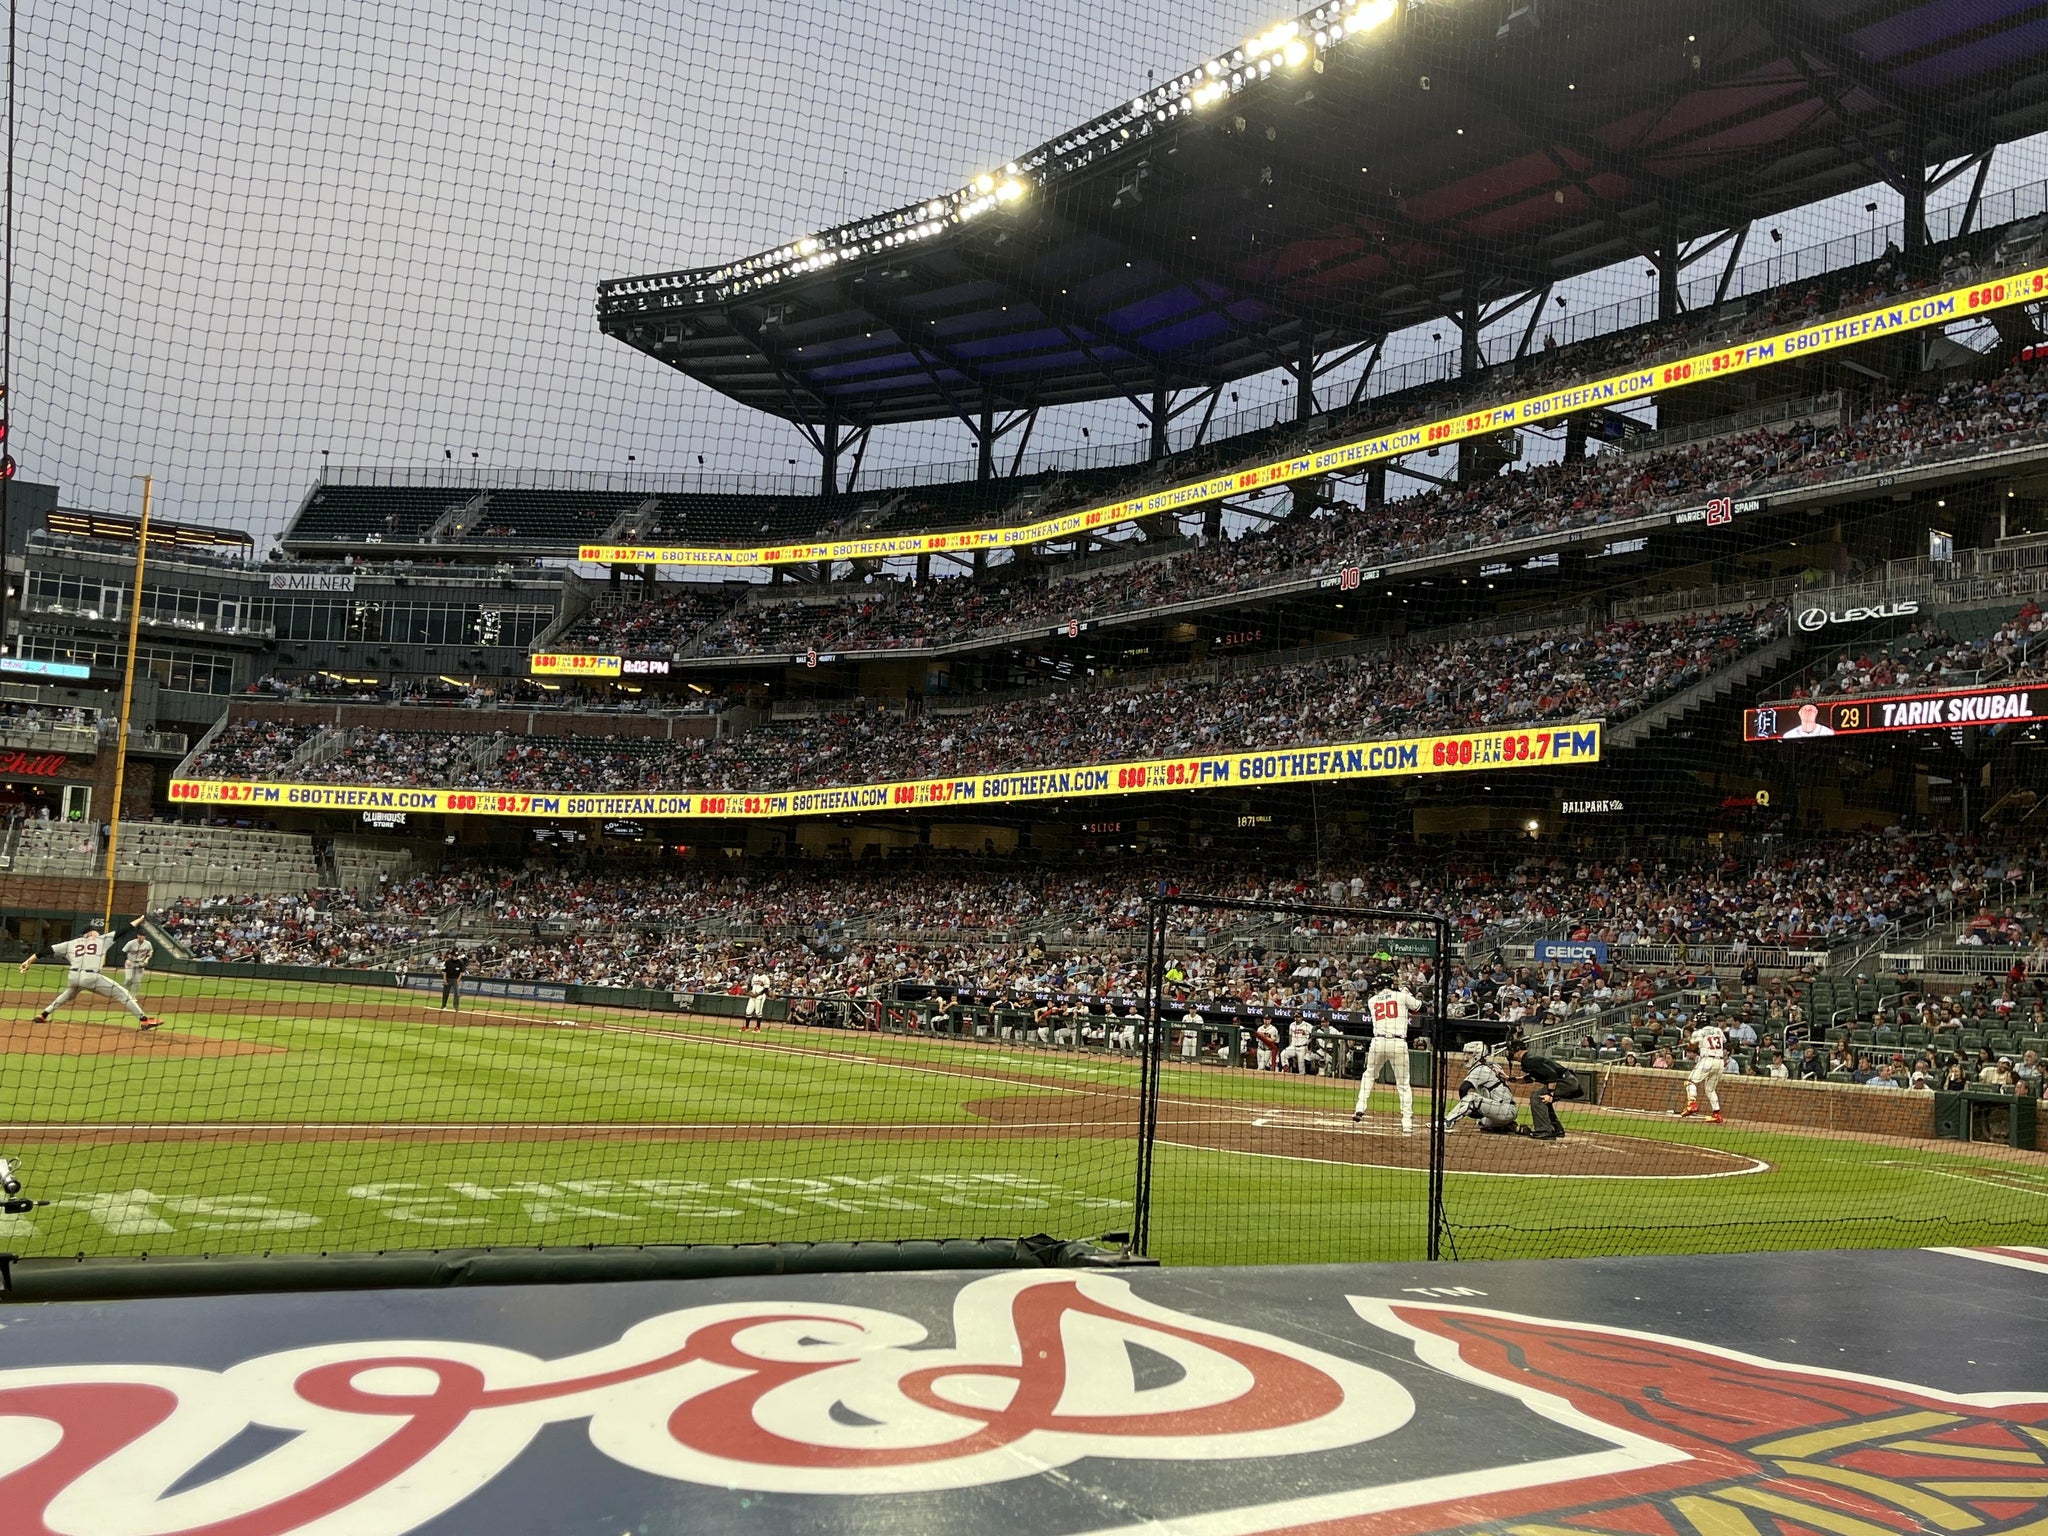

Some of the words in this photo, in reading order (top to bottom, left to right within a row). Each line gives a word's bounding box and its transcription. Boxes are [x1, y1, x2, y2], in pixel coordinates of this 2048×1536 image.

[2007, 278, 2030, 291] THE
[1969, 285, 2004, 308] 680
[2007, 288, 2030, 300] FAN
[1784, 297, 1954, 353] 680THEFAN.COM
[1692, 358, 1711, 369] THE
[1664, 364, 1690, 383] 680
[1692, 366, 1711, 378] FAN
[1523, 373, 1654, 417] 680THEFAN.COM
[1428, 425, 1450, 441] 680
[1316, 432, 1420, 468] 680THEFAN.COM
[1240, 473, 1256, 487] 680
[1148, 479, 1233, 509] 680THEFAN.COM
[1676, 510, 1706, 524] WARREN
[1707, 497, 1732, 526] 21
[1735, 501, 1759, 513] SPAHN
[1086, 514, 1100, 525] 680
[1004, 517, 1080, 542] 680THEFAN.COM
[833, 539, 922, 556] 680THEFAN.COM
[928, 538, 946, 549] 680
[581, 549, 600, 559] 680
[662, 551, 758, 562] 680THEFAN.COM
[764, 550, 780, 560] 680
[289, 575, 351, 590] MILNER
[1341, 567, 1360, 590] 10
[1830, 601, 1919, 623] LEXUS
[1069, 619, 1078, 637] 6
[1225, 630, 1261, 645] SLICE
[535, 656, 556, 666] 680
[807, 651, 816, 667] 3
[623, 661, 648, 673] 8:02
[650, 662, 669, 674] PM
[1840, 709, 1859, 729] 29
[1883, 700, 1944, 727] TARIK
[1948, 693, 2033, 722] SKUBAL
[1474, 738, 1501, 751] THE
[1433, 741, 1472, 766] 680
[1474, 750, 1501, 763] FAN
[1239, 745, 1418, 780] 680THEFAN.COM
[1118, 767, 1146, 788] 680
[1147, 765, 1165, 776] THE
[201, 784, 219, 793] THE
[982, 770, 1109, 797] 680THEFAN.COM
[1147, 775, 1165, 787] FAN
[172, 783, 199, 799] 680
[201, 791, 219, 800] FAN
[894, 786, 915, 804] 680
[915, 784, 930, 794] THE
[289, 788, 436, 808] 680THEFAN.COM
[447, 795, 476, 810] 680
[477, 796, 496, 804] THE
[726, 798, 744, 806] THE
[792, 788, 888, 811] 680THEFAN.COM
[915, 792, 930, 803] FAN
[477, 803, 496, 811] FAN
[567, 798, 691, 814] 680THEFAN.COM
[700, 797, 725, 814] 680
[726, 805, 744, 814] FAN
[1562, 800, 1609, 813] BALLPARK
[362, 811, 406, 824] CLUBHOUSE
[1237, 816, 1255, 827] 1871
[1090, 822, 1121, 833] SLICE
[75, 943, 98, 958] 29
[1545, 946, 1596, 959] GEICO
[1374, 1000, 1398, 1021] 20
[1706, 1034, 1722, 1050] 13
[347, 1173, 1062, 1203] CHEROKEE
[385, 1190, 1133, 1226] CASINOS
[1402, 1285, 1488, 1300] TM
